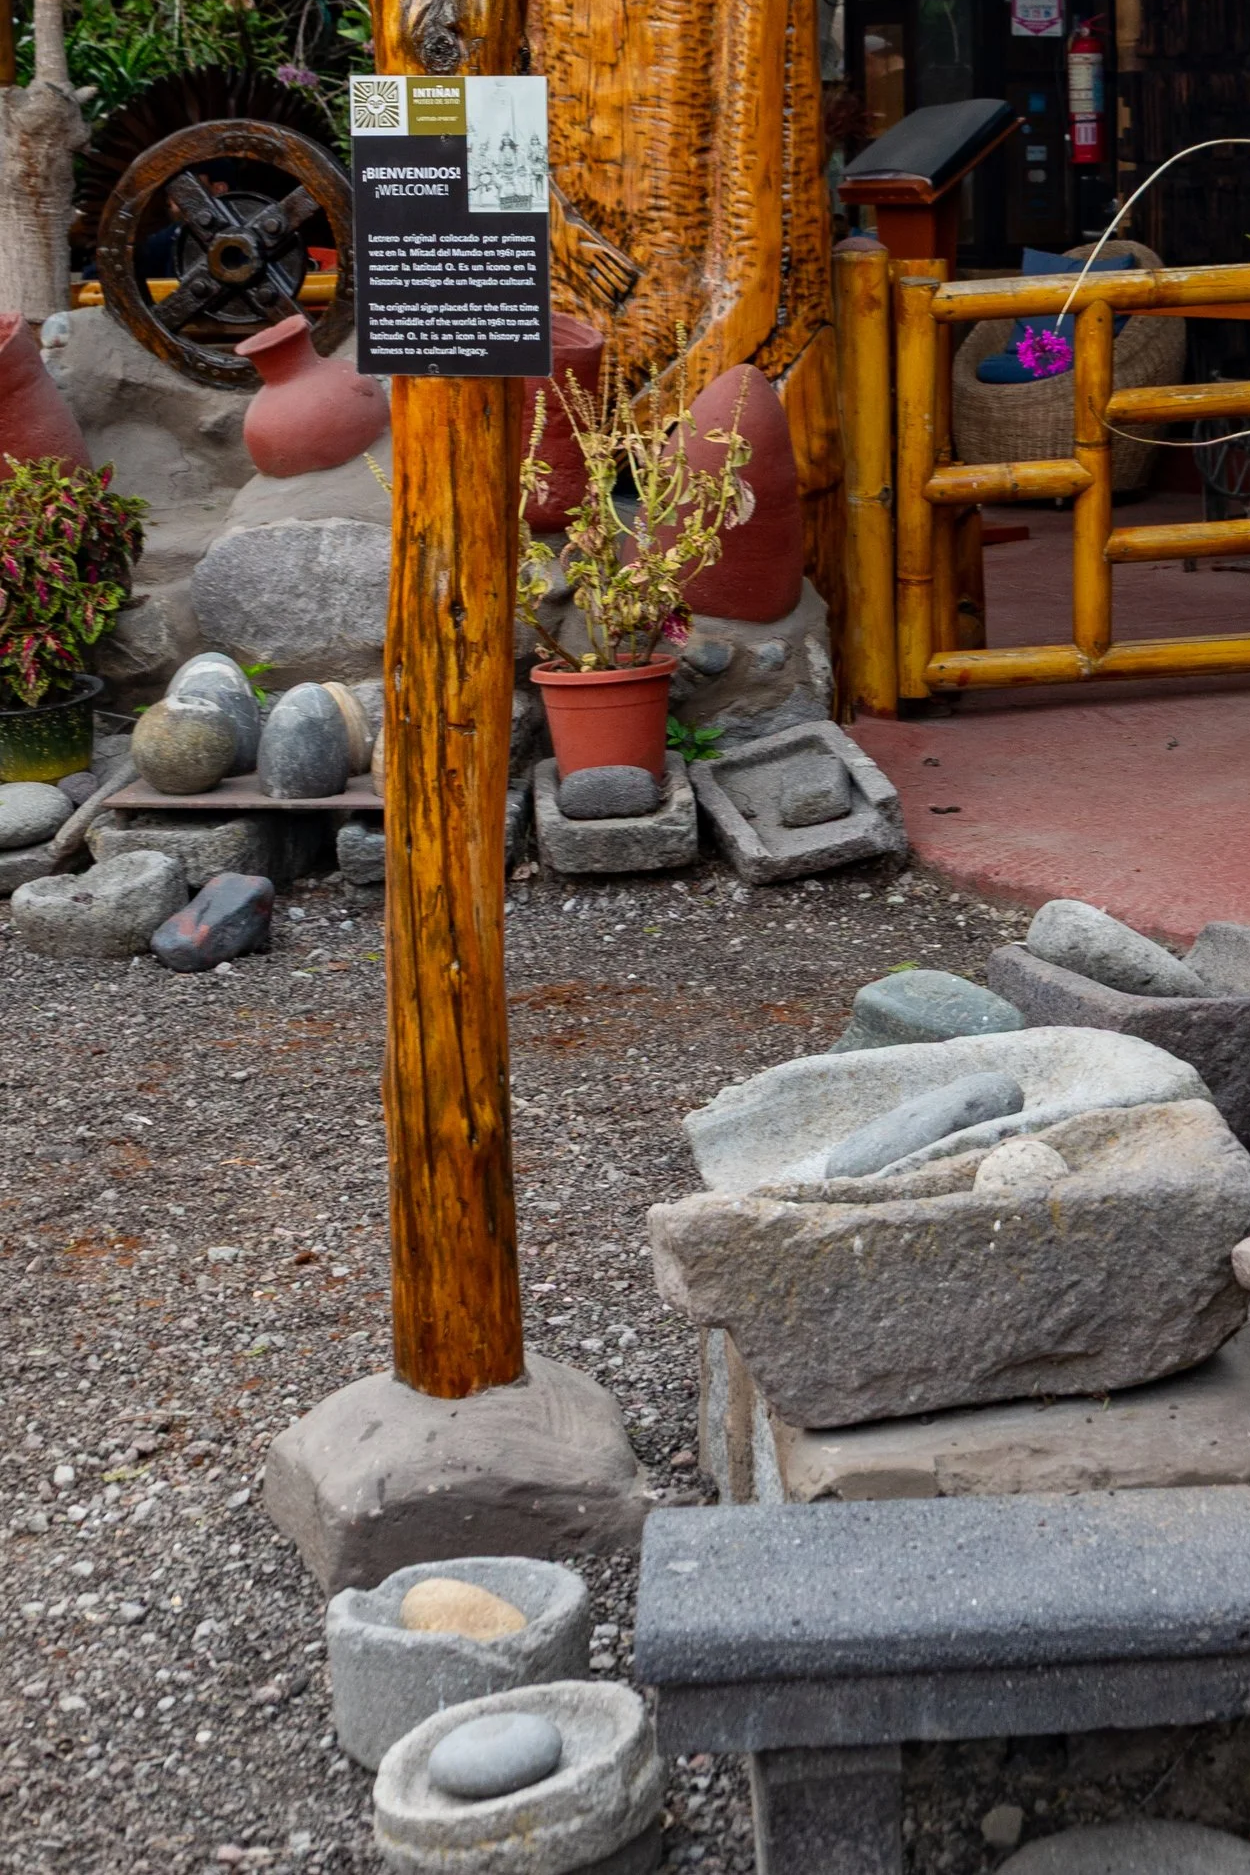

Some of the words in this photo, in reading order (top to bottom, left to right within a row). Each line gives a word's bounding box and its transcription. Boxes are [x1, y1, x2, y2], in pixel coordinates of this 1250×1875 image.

[413, 85, 460, 98] INTIÑAN
[362, 167, 461, 182] ¡BIENVENIDOS!
[375, 184, 449, 198] ¡WELCOME!
[368, 234, 400, 242] Letrero
[403, 234, 436, 244] original
[439, 234, 480, 242] colocado
[482, 235, 499, 244] por
[502, 234, 536, 244] primera
[398, 248, 406, 257] la
[410, 248, 436, 257] Mitad
[437, 248, 451, 257] del
[452, 248, 483, 257] Mundo
[516, 250, 536, 258] para
[401, 263, 410, 271] la
[413, 263, 443, 271] latitud
[458, 263, 469, 271] Es
[527, 263, 536, 271] la
[370, 277, 403, 285] historia
[411, 277, 442, 287] testigo
[443, 277, 455, 285] de
[468, 277, 498, 287] legado
[499, 277, 536, 285] cultural.
[369, 303, 385, 311] The
[386, 303, 419, 313] original
[420, 303, 438, 313] sign
[439, 303, 468, 313] placed
[469, 303, 482, 311] for
[484, 303, 499, 311] the
[500, 303, 518, 311] first
[519, 303, 539, 311] time
[369, 317, 378, 326] in
[379, 317, 394, 326] the
[395, 317, 424, 326] middle
[425, 317, 435, 326] of
[436, 317, 451, 326] the
[452, 317, 477, 326] world
[477, 317, 487, 326] in
[517, 317, 540, 326] mark
[370, 331, 404, 340] latitude
[420, 331, 429, 340] It
[431, 331, 439, 340] is
[456, 331, 475, 340] icon
[477, 331, 487, 340] in
[489, 331, 520, 342] history
[522, 331, 540, 340] and
[370, 346, 404, 354] witness
[423, 346, 457, 354] cultural
[458, 346, 488, 356] legacy.
